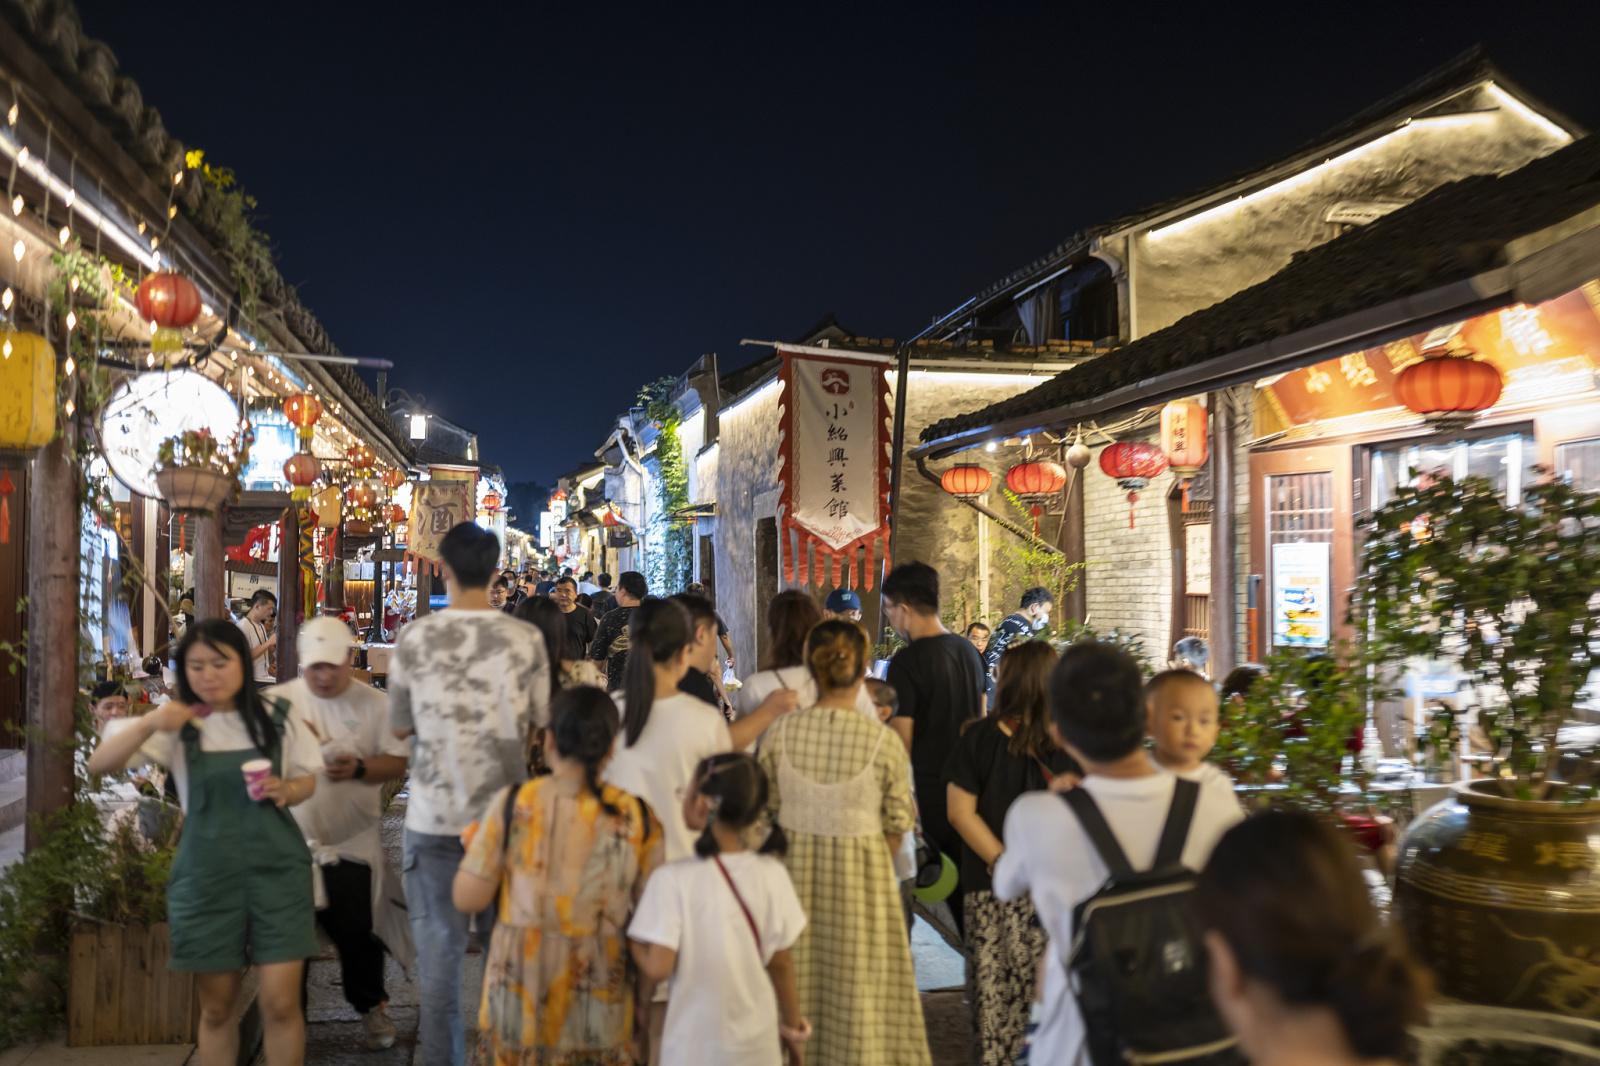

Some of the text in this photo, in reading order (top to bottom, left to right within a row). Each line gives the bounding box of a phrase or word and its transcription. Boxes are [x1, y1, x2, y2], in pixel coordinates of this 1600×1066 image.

[823, 403, 849, 520] 小紹興菜館
